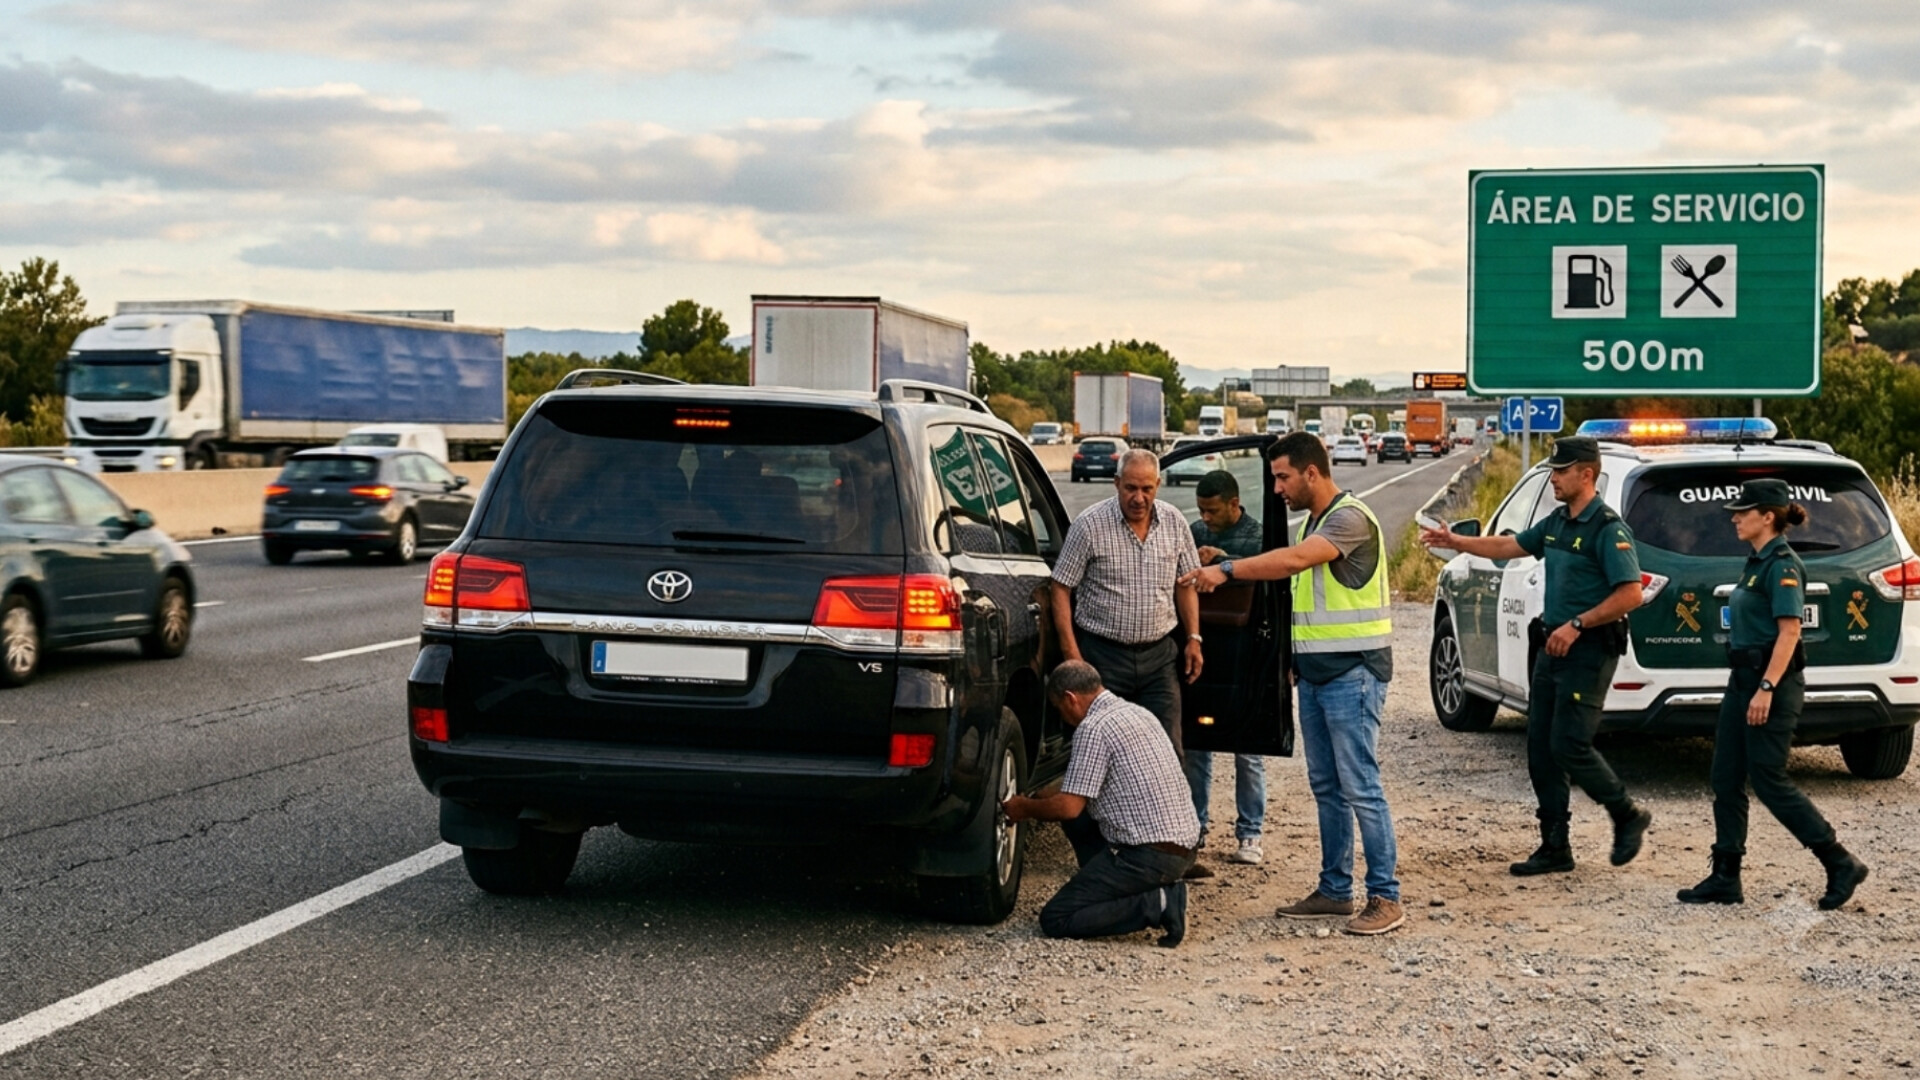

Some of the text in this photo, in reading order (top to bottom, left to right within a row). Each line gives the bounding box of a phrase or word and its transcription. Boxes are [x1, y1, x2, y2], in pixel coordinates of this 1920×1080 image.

[1487, 189, 1805, 224] ÁREA DE SERVICIO
[1582, 340, 1704, 371] 500m
[1512, 404, 1558, 421] AP-7
[1679, 485, 1744, 503] GUAR
